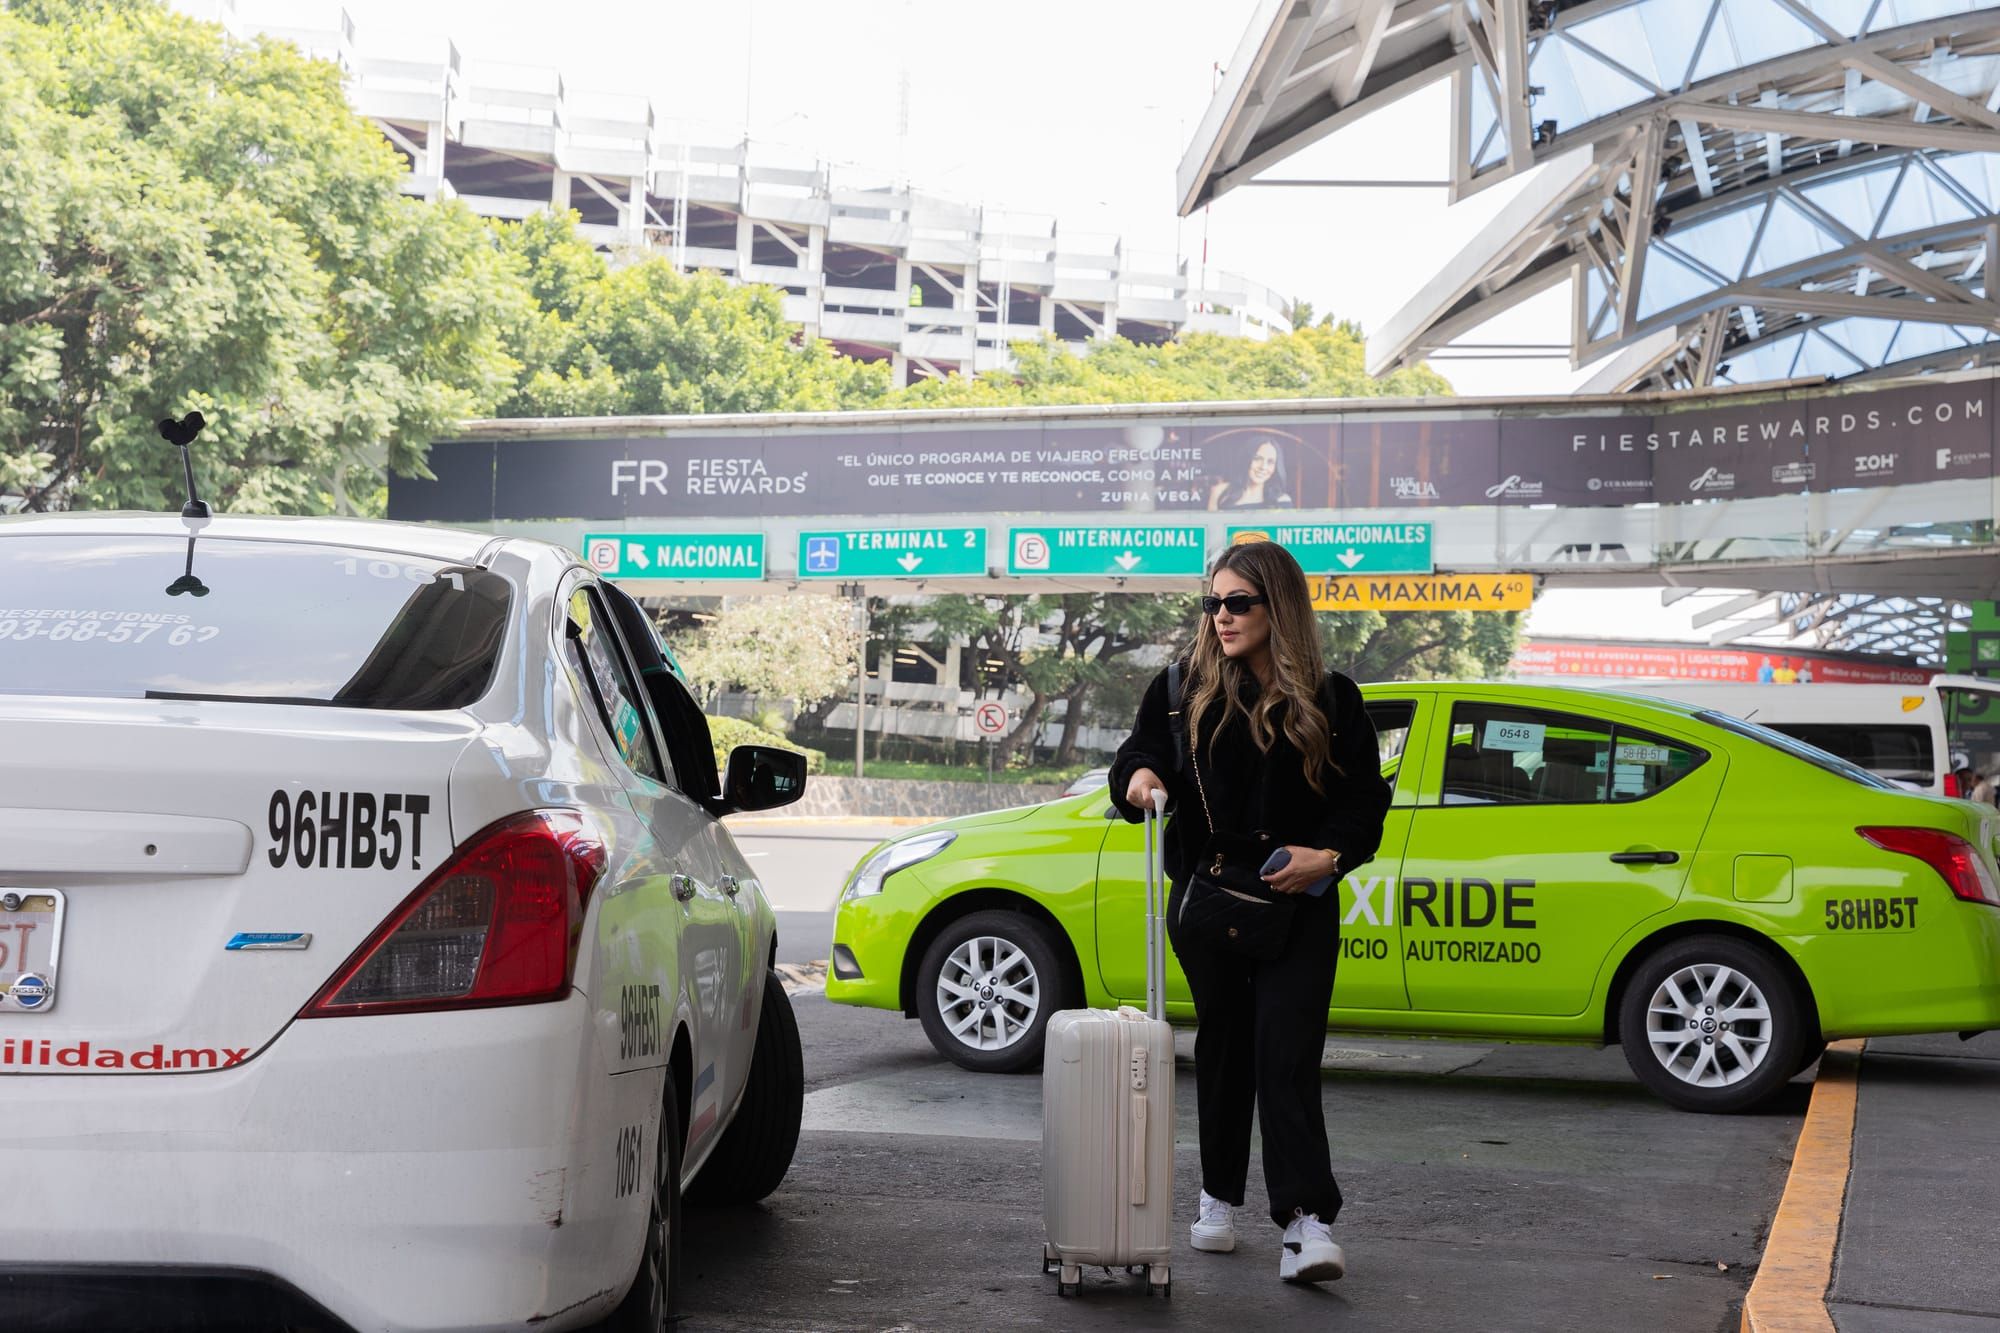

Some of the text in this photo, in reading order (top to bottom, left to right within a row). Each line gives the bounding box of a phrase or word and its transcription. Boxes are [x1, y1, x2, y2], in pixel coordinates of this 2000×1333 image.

[1573, 399, 1983, 453] FIESTAREWARDS.COM
[866, 452, 915, 466] ÚNICO
[919, 451, 1006, 465] PROGRAMA
[1011, 451, 1032, 463] DE
[1036, 450, 1104, 463] VIAJERO
[1108, 448, 1202, 464] FRECUENTE
[687, 459, 767, 476] FIESTA
[611, 460, 669, 496] FR
[686, 475, 807, 494] REWARDS
[868, 473, 900, 486] QUE
[904, 473, 922, 485] TE
[925, 471, 985, 484] CONOCE
[988, 471, 998, 483] Y
[1000, 471, 1018, 483] TE
[1021, 470, 1105, 484] RECONOCE,
[1107, 469, 1156, 482] COMO
[1160, 469, 1172, 481] A
[1101, 490, 1202, 502] ZURIA VEGA
[845, 530, 976, 549] TERMINAL 2
[1058, 530, 1199, 547] INTERNACIONAL
[1276, 526, 1426, 545] INTERNACIONALES
[657, 545, 759, 567] NACIONAL
[332, 557, 465, 592] 1061
[1369, 582, 1482, 601] MAXIMA
[1500, 727, 1530, 740] 0548
[268, 788, 430, 871] 96HB5T
[1825, 896, 1919, 930] 58HB5T
[1406, 940, 1542, 964] AUTORIZADO
[11, 986, 50, 995] NISSAN
[620, 984, 662, 1060] 96HB5T
[615, 1124, 642, 1199] 1061
